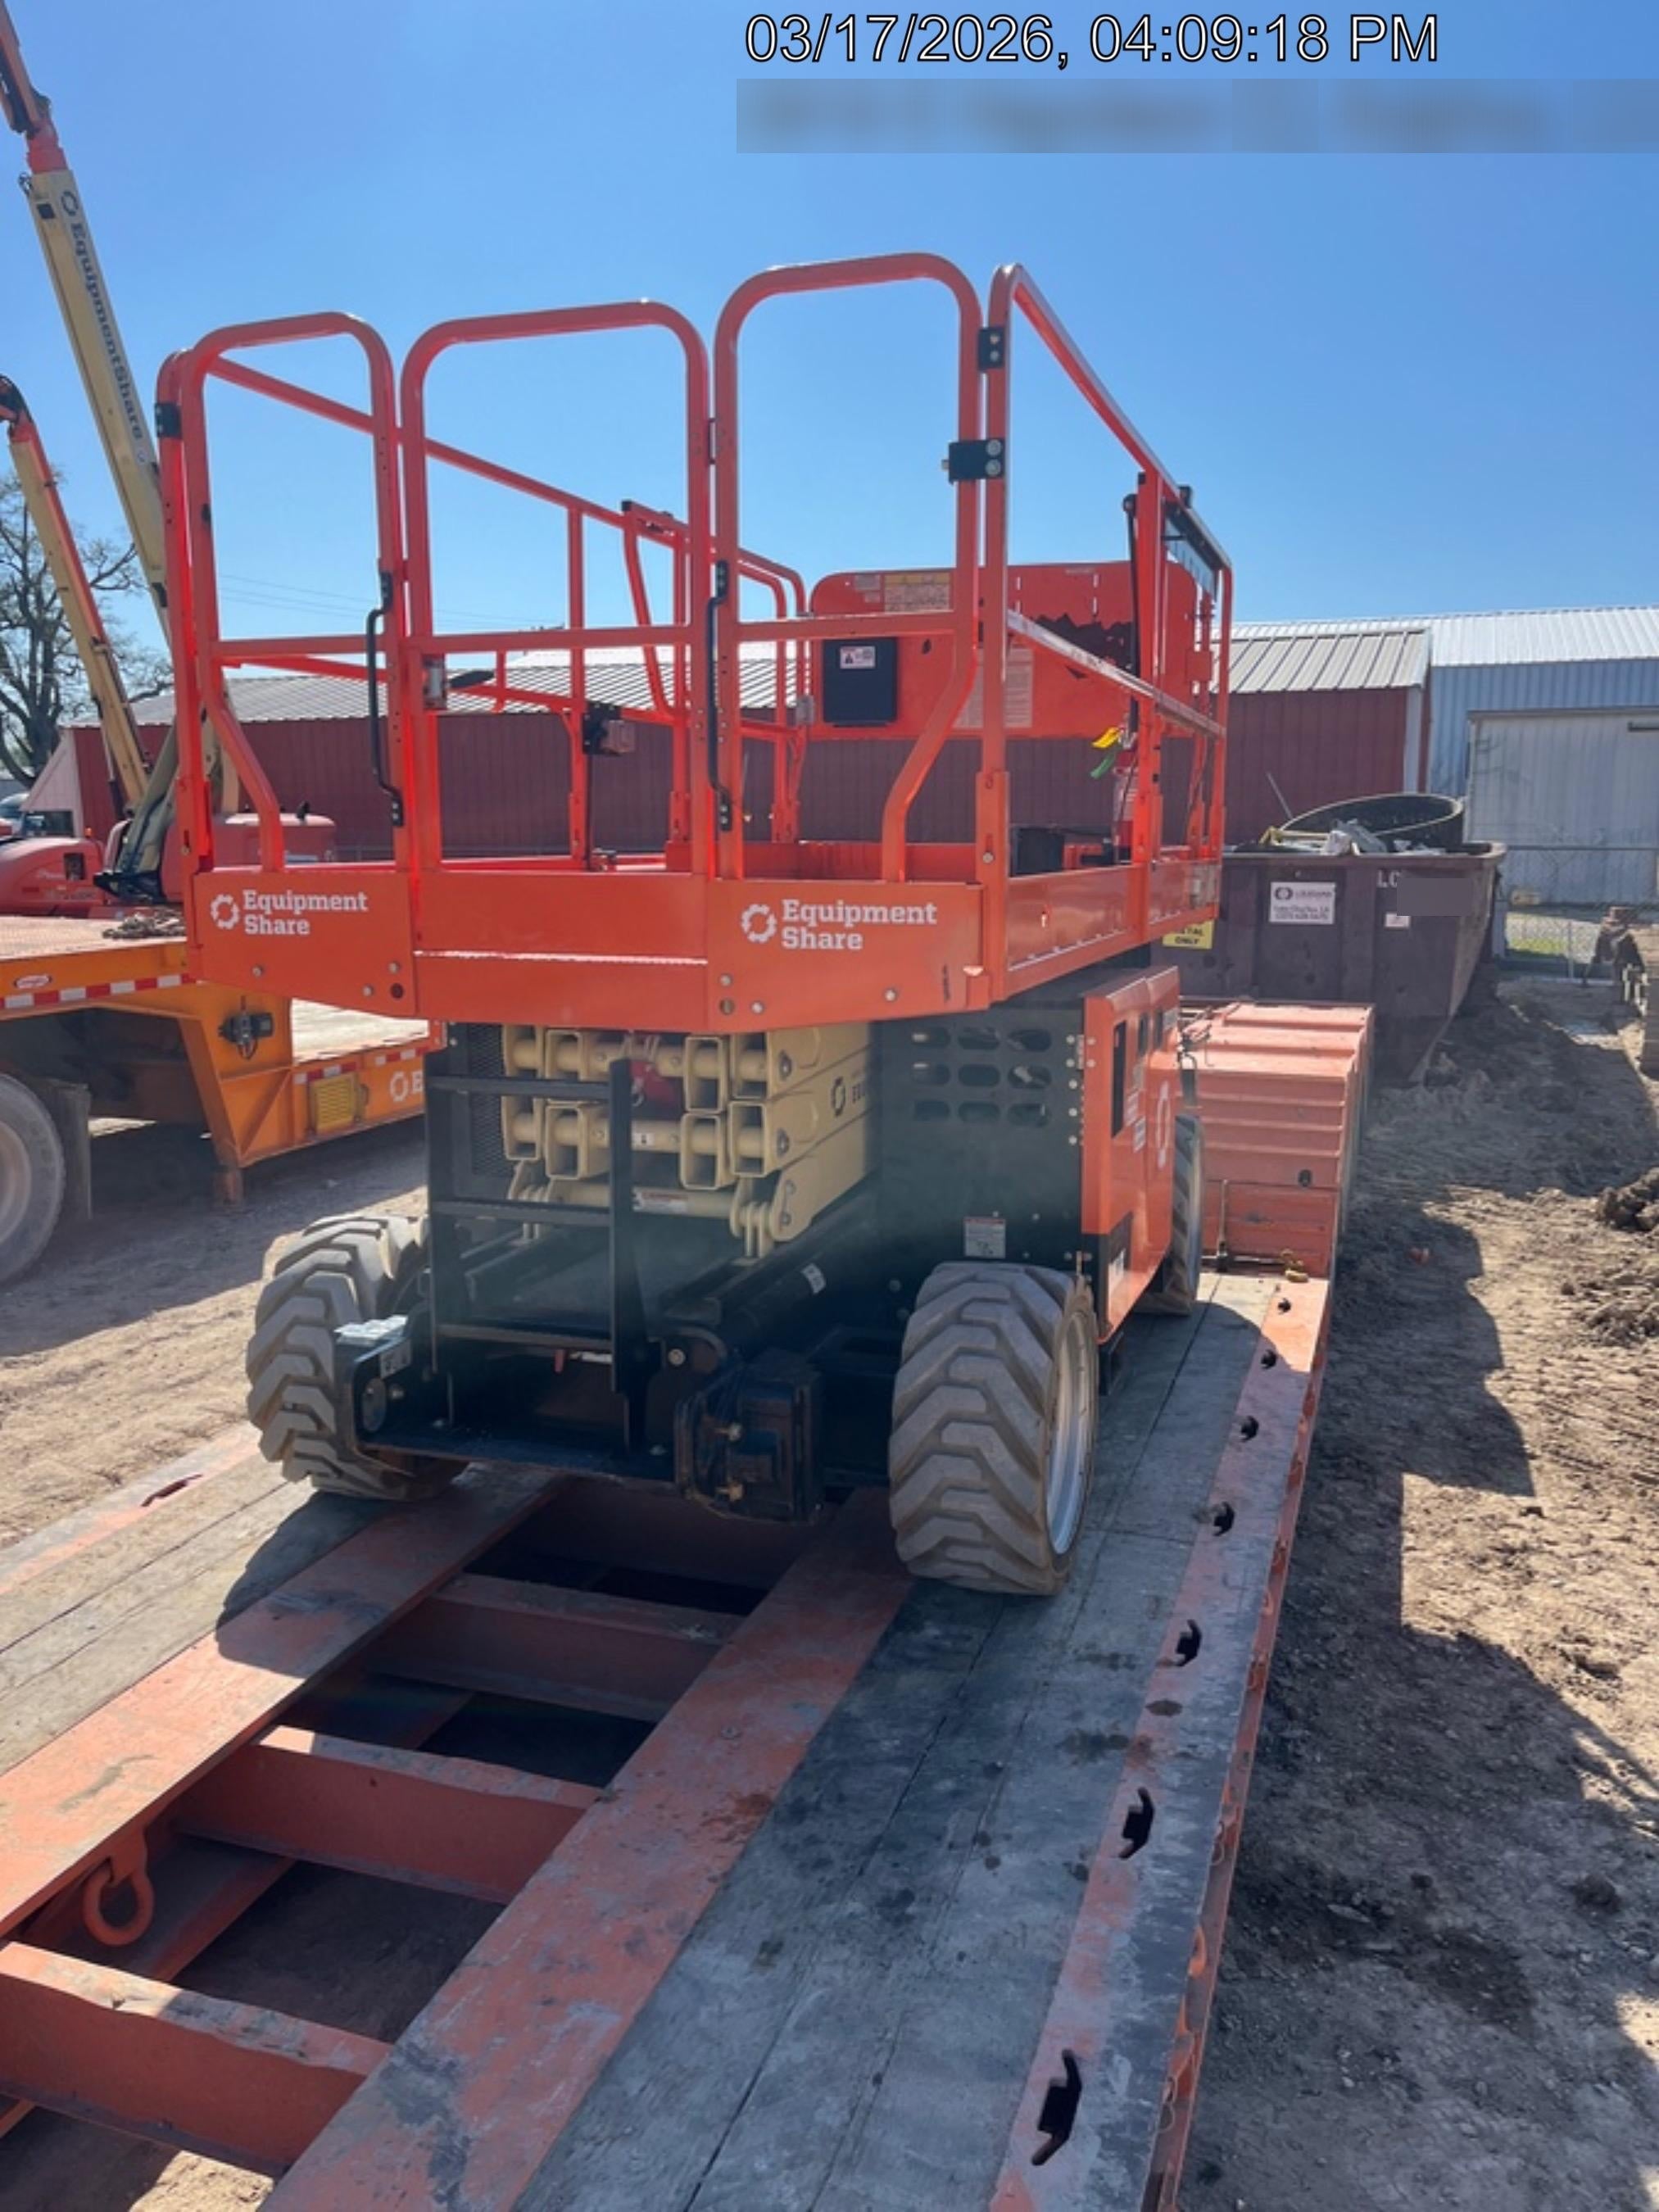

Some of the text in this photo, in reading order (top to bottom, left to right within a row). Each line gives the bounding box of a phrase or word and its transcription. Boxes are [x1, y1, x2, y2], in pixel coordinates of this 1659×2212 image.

[71, 222, 143, 441] EquipmentShare
[243, 889, 368, 915] Equipment
[781, 899, 938, 927] Equipment
[245, 913, 310, 936] Share
[781, 926, 863, 950] Share
